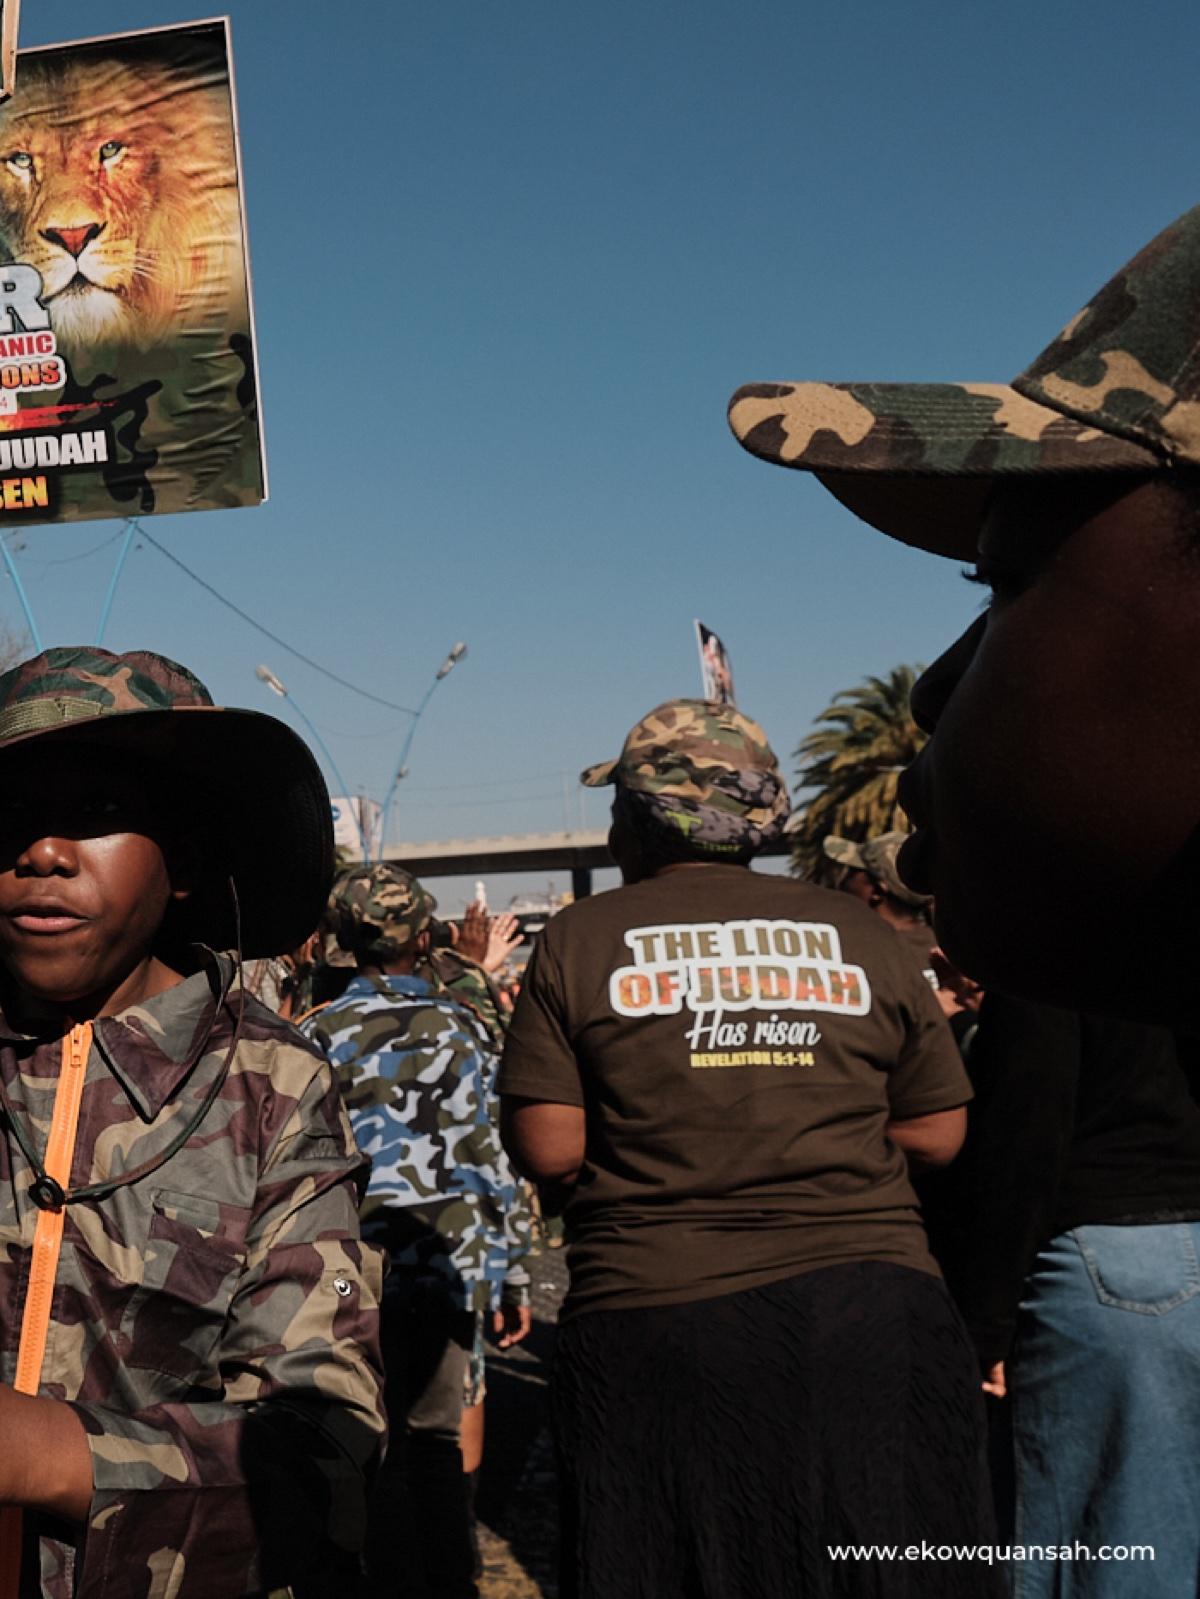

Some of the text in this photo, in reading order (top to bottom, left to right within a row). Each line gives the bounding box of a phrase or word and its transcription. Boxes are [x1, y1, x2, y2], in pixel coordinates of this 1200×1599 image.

[634, 926, 834, 963] THE LION
[618, 965, 862, 1009] OF JUDAH
[685, 1009, 821, 1050] Has risen
[690, 1051, 815, 1068] REVELATION 5:1-14
